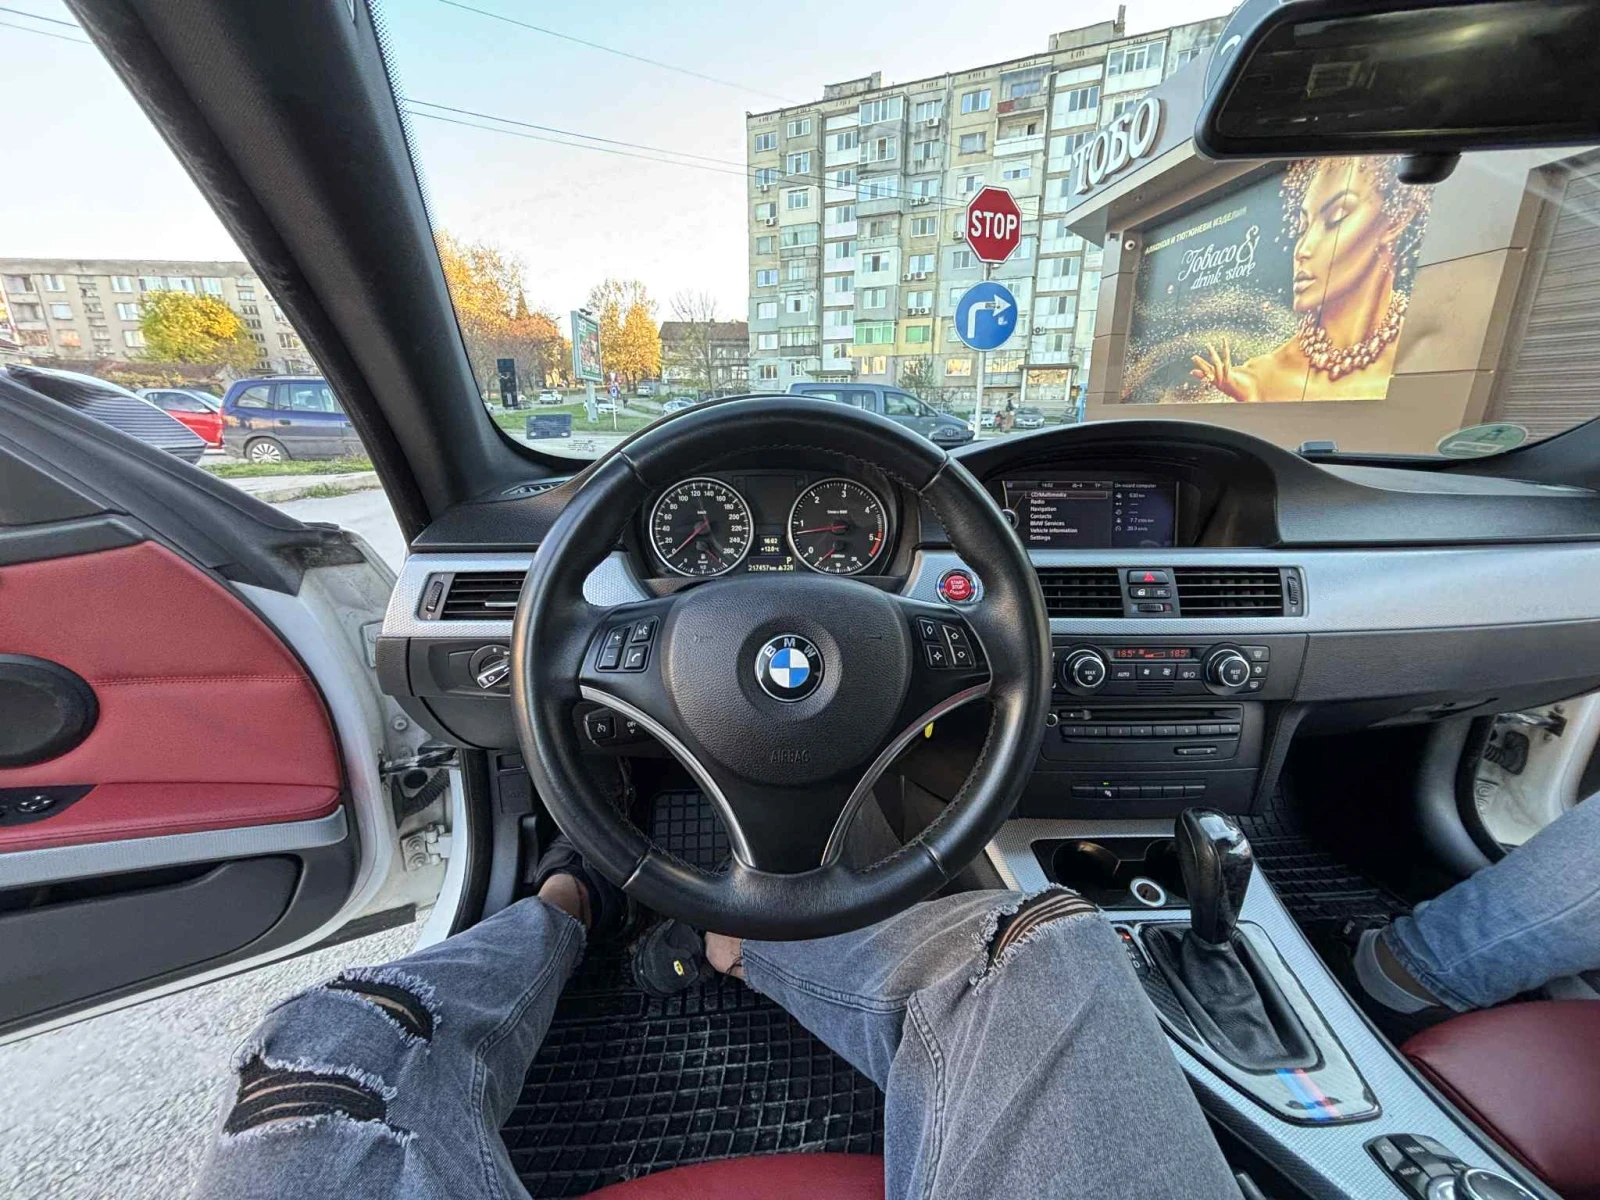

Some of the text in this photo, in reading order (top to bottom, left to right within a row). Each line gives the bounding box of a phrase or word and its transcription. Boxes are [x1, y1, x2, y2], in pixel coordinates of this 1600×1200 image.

[1073, 97, 1161, 195] ТОБО
[970, 210, 1018, 240] STOP
[1178, 225, 1260, 281] Tobaco &
[1190, 262, 1256, 290] drink store
[841, 490, 847, 498] 3
[814, 496, 820, 504] 2
[865, 506, 870, 514] 4
[869, 533, 874, 541] 5
[808, 546, 814, 554] 0
[786, 556, 792, 564] P
[764, 637, 816, 659] BMW
[770, 749, 812, 764] AIRBAG
